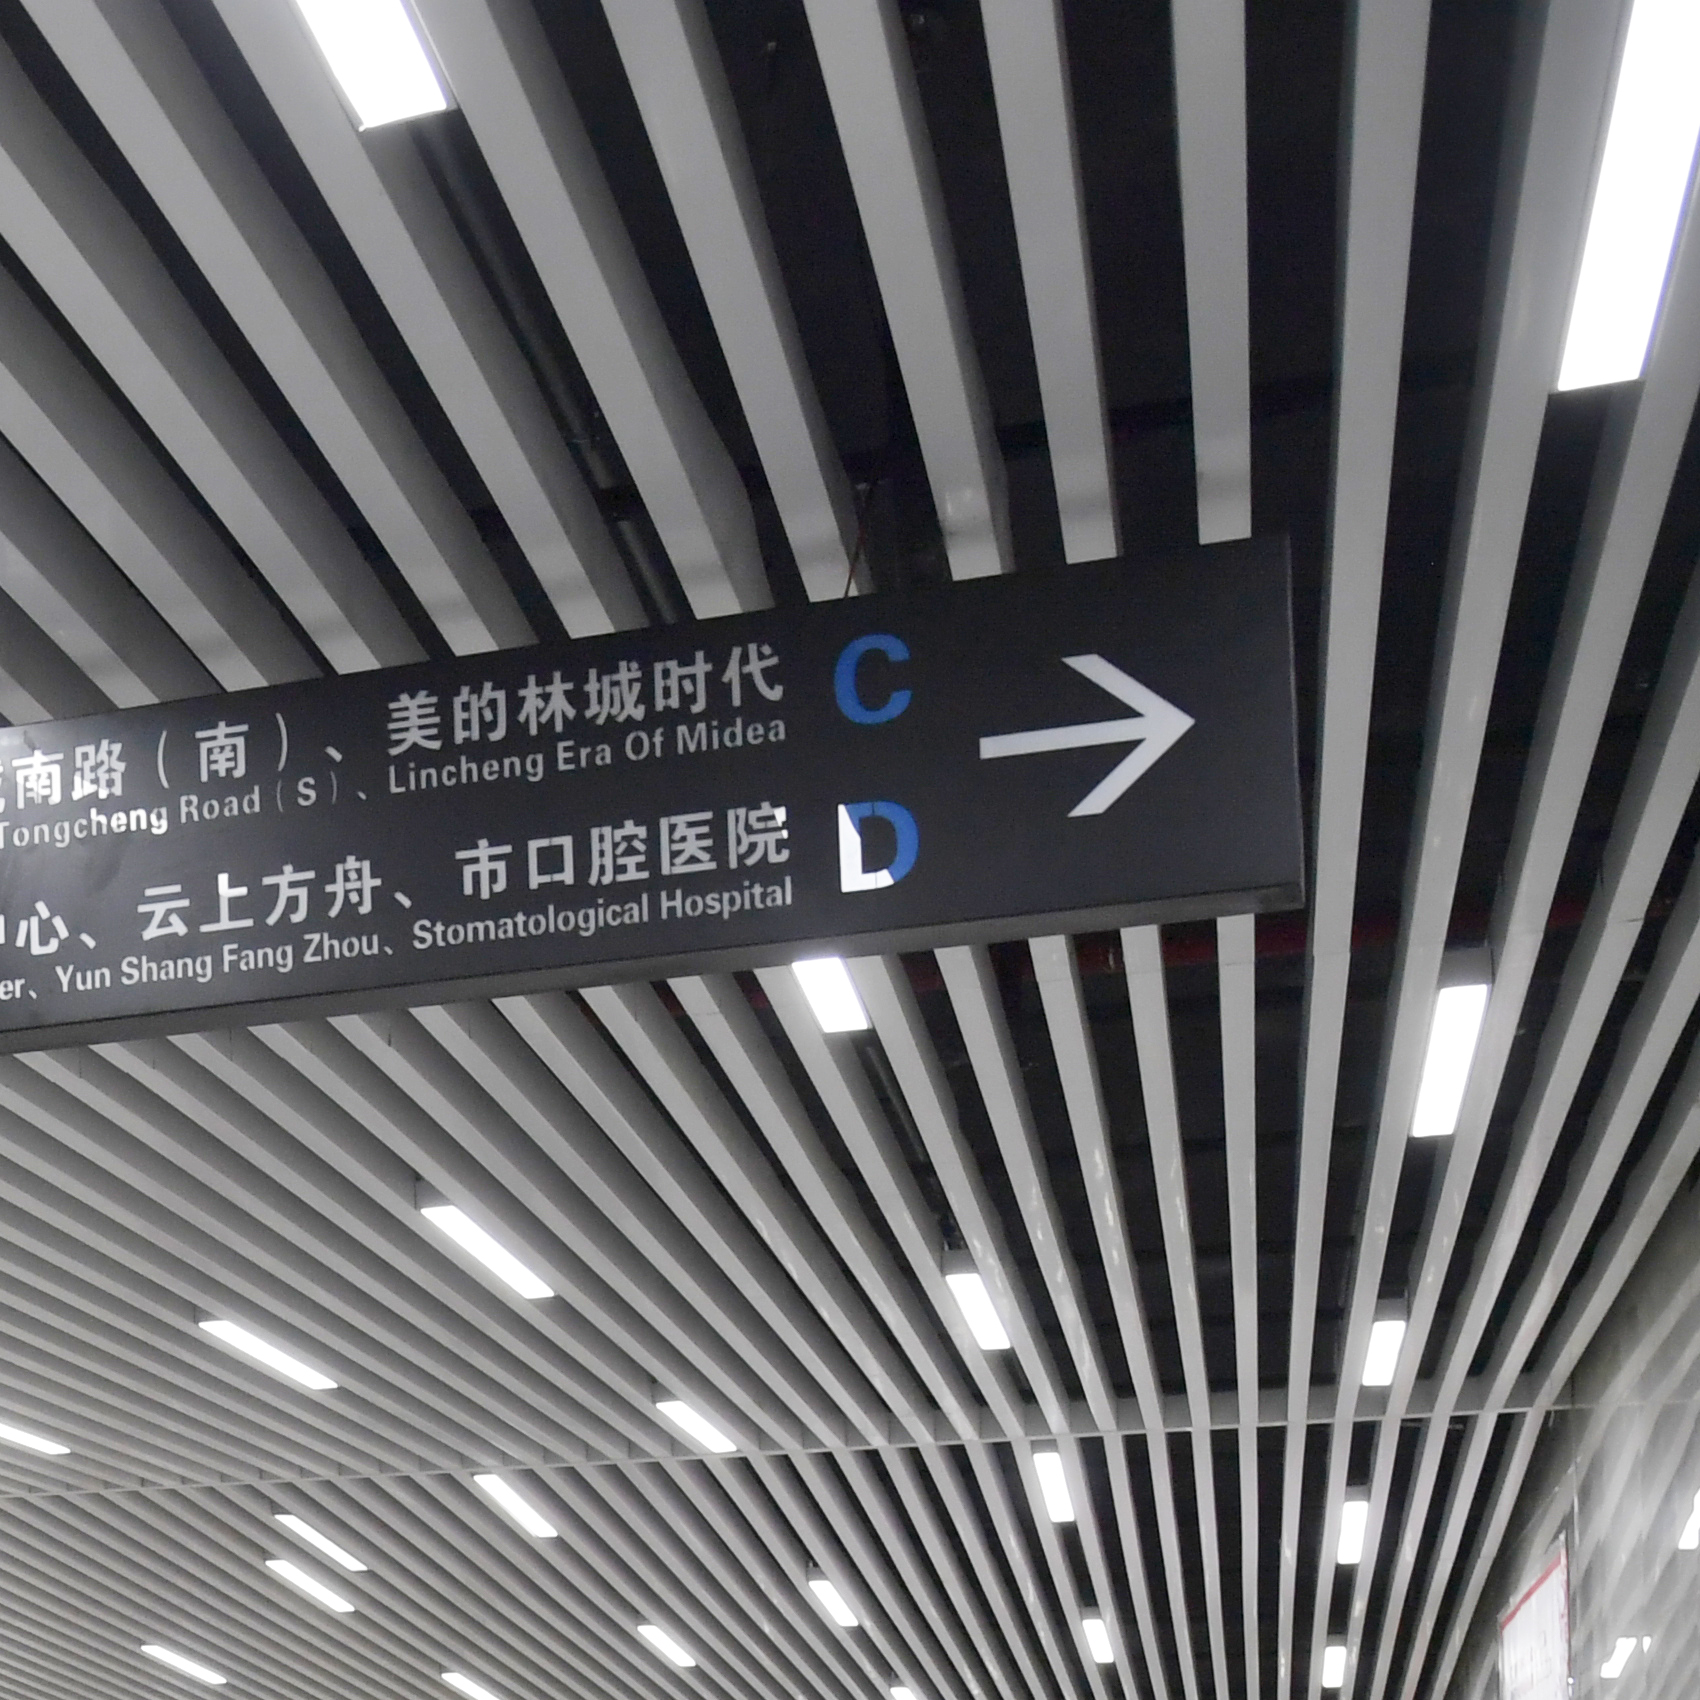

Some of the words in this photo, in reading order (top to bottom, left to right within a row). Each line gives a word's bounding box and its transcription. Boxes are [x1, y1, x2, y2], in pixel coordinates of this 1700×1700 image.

[833, 633, 912, 725] C
[180, 785, 261, 824] Road
[389, 751, 544, 793] Lincheng
[557, 739, 612, 772] Era
[625, 726, 665, 761] Of
[677, 715, 787, 755] Midea
[837, 801, 919, 893] D
[55, 963, 112, 993] Yun
[120, 952, 213, 986] Shang
[222, 943, 293, 974] Fang
[412, 897, 650, 950] Stomatological
[660, 875, 794, 921] Hospital
